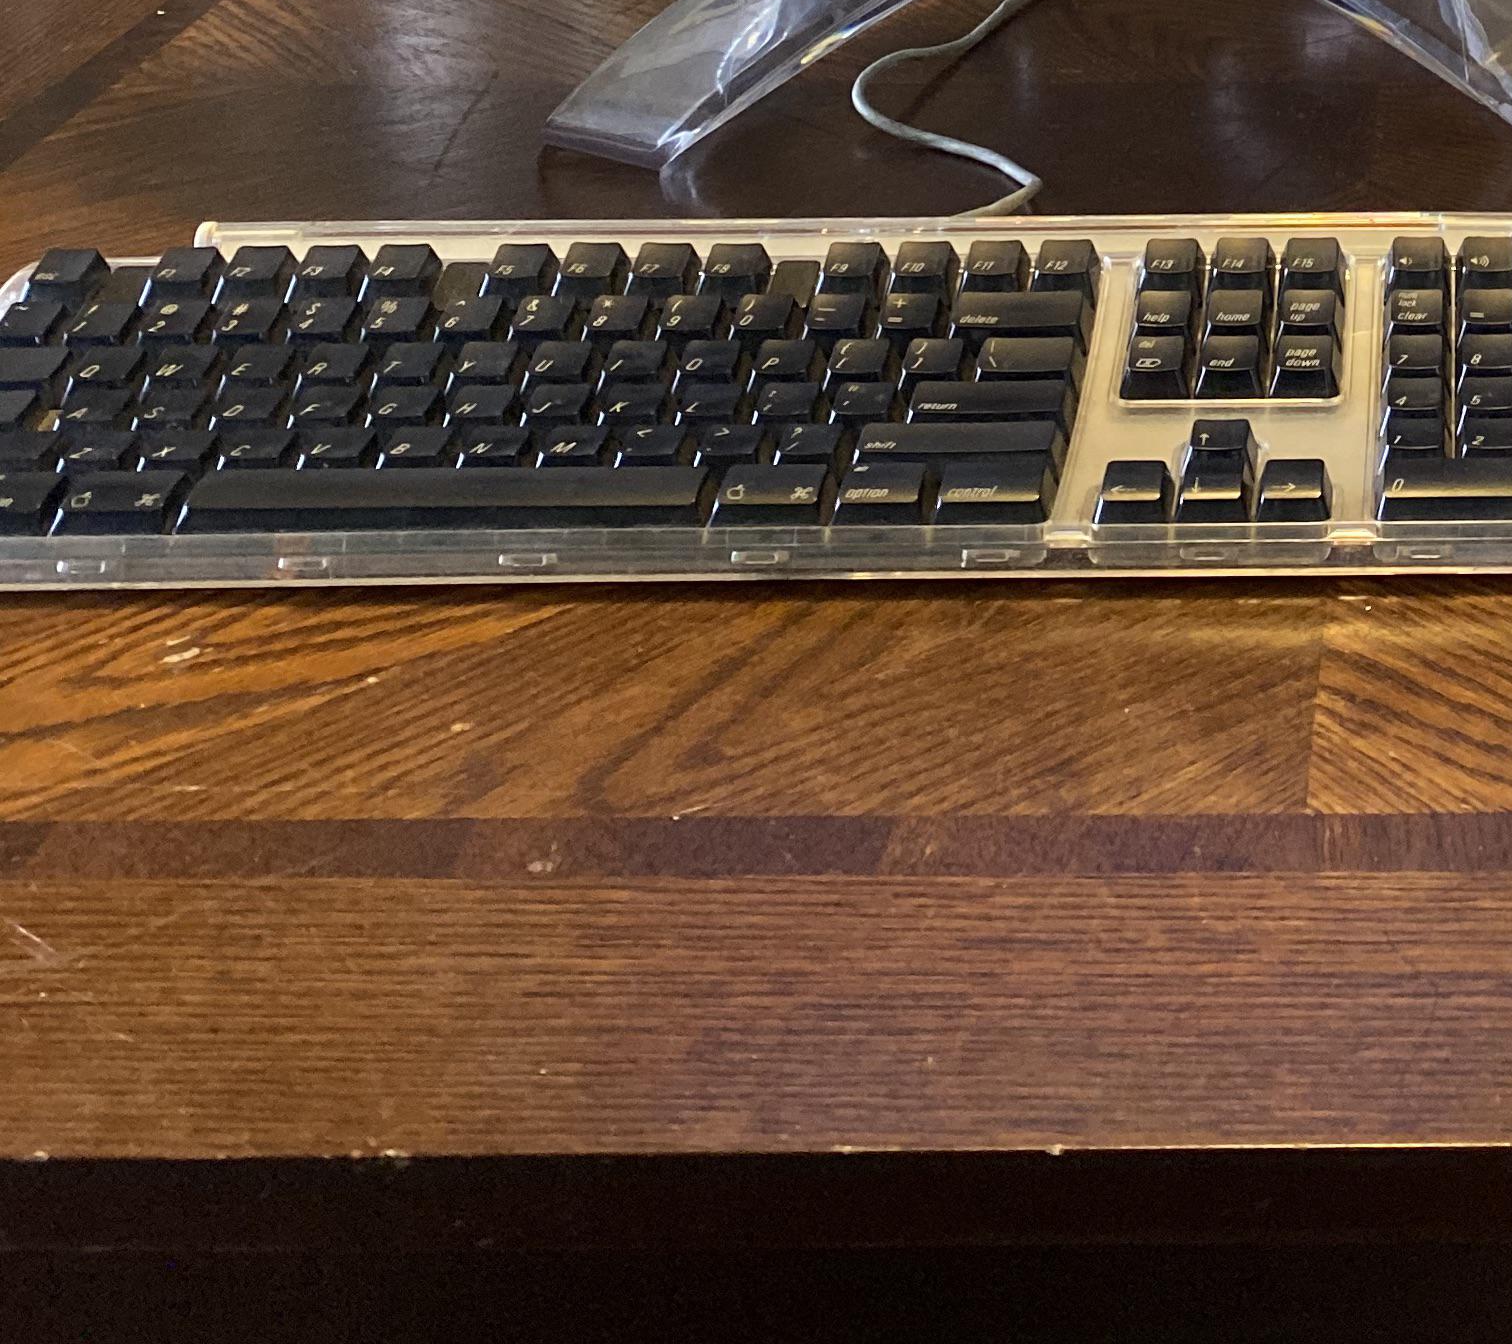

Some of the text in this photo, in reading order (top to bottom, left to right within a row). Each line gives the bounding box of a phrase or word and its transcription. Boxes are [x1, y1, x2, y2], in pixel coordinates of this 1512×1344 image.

[710, 263, 731, 274] F8
[830, 263, 849, 272] F9
[900, 262, 926, 272] F10
[972, 260, 994, 271] F11
[1044, 260, 1068, 270] F12
[1150, 260, 1174, 269] F13
[1222, 258, 1244, 268] F14
[1292, 258, 1314, 268] F15
[157, 268, 176, 278] F1
[229, 266, 252, 277] F2
[302, 266, 324, 276] F3
[374, 266, 394, 276] F4
[494, 264, 516, 274] F5
[567, 264, 588, 274] F6
[640, 264, 661, 274] F7
[526, 298, 540, 312] &
[1290, 302, 1320, 312] page
[518, 315, 536, 326] 7
[592, 315, 608, 327] 8
[666, 315, 682, 327] 9
[959, 314, 999, 324] delete
[1142, 312, 1170, 323] help
[1216, 312, 1250, 322] home
[1290, 314, 1306, 322] up
[1398, 312, 1428, 320] clear
[148, 320, 166, 332] 2
[220, 320, 239, 332] 3
[298, 318, 314, 330] 4
[370, 316, 386, 329] 5
[444, 316, 460, 328] 6
[1286, 348, 1317, 358] page
[761, 356, 780, 370] P
[1209, 358, 1234, 368] end
[1286, 358, 1320, 367] down
[1397, 354, 1408, 365] 7
[1470, 354, 1482, 364] 8
[154, 364, 184, 376] W
[230, 362, 252, 376] E
[307, 362, 328, 375] R
[382, 361, 402, 374] T
[458, 360, 477, 373] Y
[534, 360, 554, 372] U
[918, 402, 958, 410] return
[1395, 395, 1408, 406] 4
[222, 404, 244, 418] D
[300, 404, 320, 416] F
[378, 403, 398, 415] G
[455, 402, 478, 414] H
[532, 402, 552, 414] J
[608, 402, 631, 412] K
[685, 402, 700, 412] L
[66, 408, 88, 420] A
[143, 406, 165, 420] S
[1392, 435, 1402, 444] 1
[1473, 435, 1485, 446] 2
[230, 445, 252, 456] C
[310, 444, 332, 455] V
[389, 444, 411, 455] B
[468, 442, 494, 454] N
[550, 442, 577, 454] M
[864, 441, 896, 450] shift
[152, 446, 177, 458] X
[1392, 478, 1405, 492] 0
[844, 488, 890, 500] option
[946, 486, 998, 498] control
